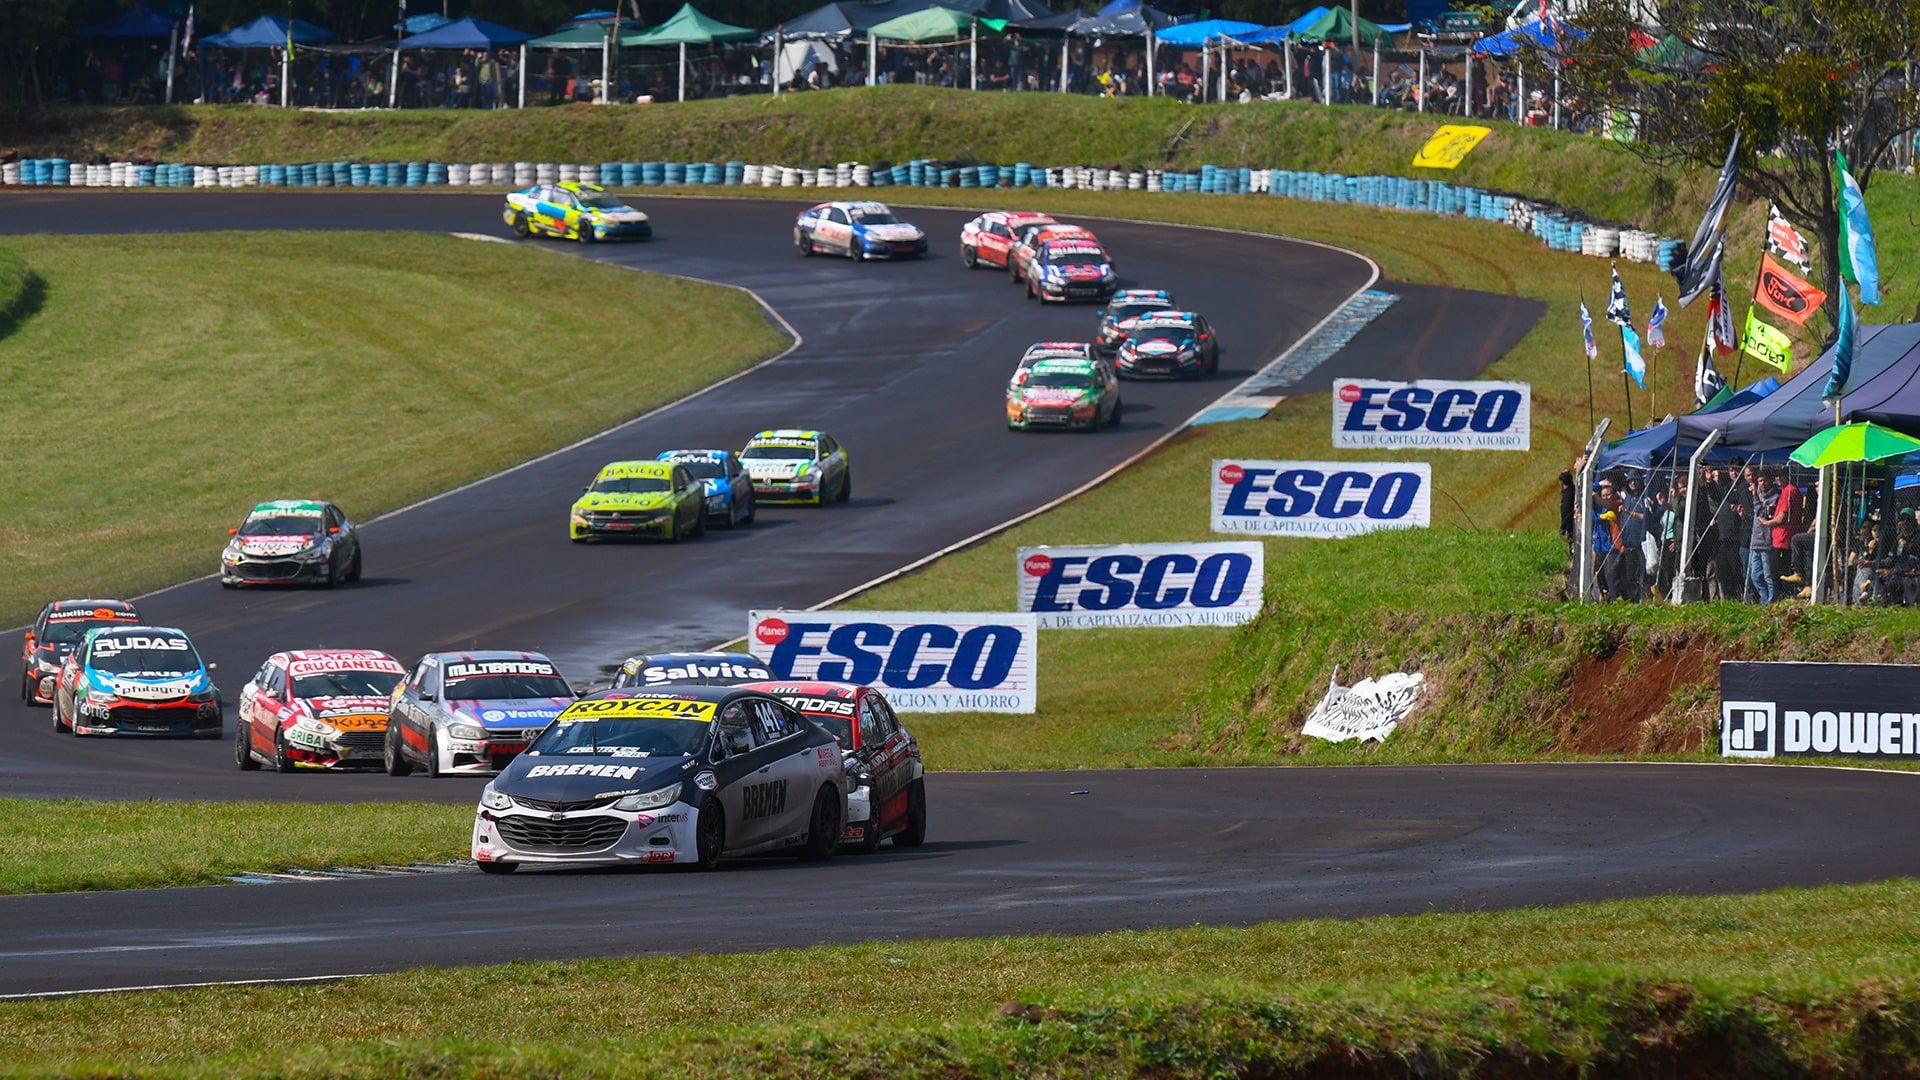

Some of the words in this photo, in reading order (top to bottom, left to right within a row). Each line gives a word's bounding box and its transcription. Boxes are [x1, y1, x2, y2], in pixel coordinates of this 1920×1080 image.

[1342, 387, 1522, 432] ESCO
[1362, 435, 1376, 444] DE
[1379, 435, 1463, 445] CAPITALIZACION
[1466, 435, 1474, 444] Y
[1475, 435, 1521, 445] AHORRO
[605, 465, 665, 478] BASILIO
[1222, 468, 1422, 519] ESCO
[590, 498, 652, 507] BASILIO
[1244, 520, 1259, 530] DE
[1263, 521, 1357, 533] CAPITALIZACION
[1360, 522, 1368, 532] Y
[1026, 560, 1051, 570] Planes
[1030, 552, 1253, 613] ESCO
[1056, 616, 1073, 627] DE
[1077, 614, 1184, 627] CAPITALIZACION
[1186, 613, 1195, 624] Y
[758, 625, 787, 637] Planes
[95, 637, 189, 651] RUDAS
[768, 622, 1022, 690] ESCO
[294, 660, 397, 673] CRUCIANELLI
[448, 662, 554, 677] MULTIBANDAS
[643, 662, 770, 682] Salvita
[121, 684, 187, 695] philagro
[569, 700, 712, 714] ROYCAN
[943, 695, 954, 707] Y
[956, 694, 1020, 708] AHORRO
[754, 702, 781, 733] 141
[527, 764, 639, 780] BREMEN
[743, 779, 787, 820] BREMEN
